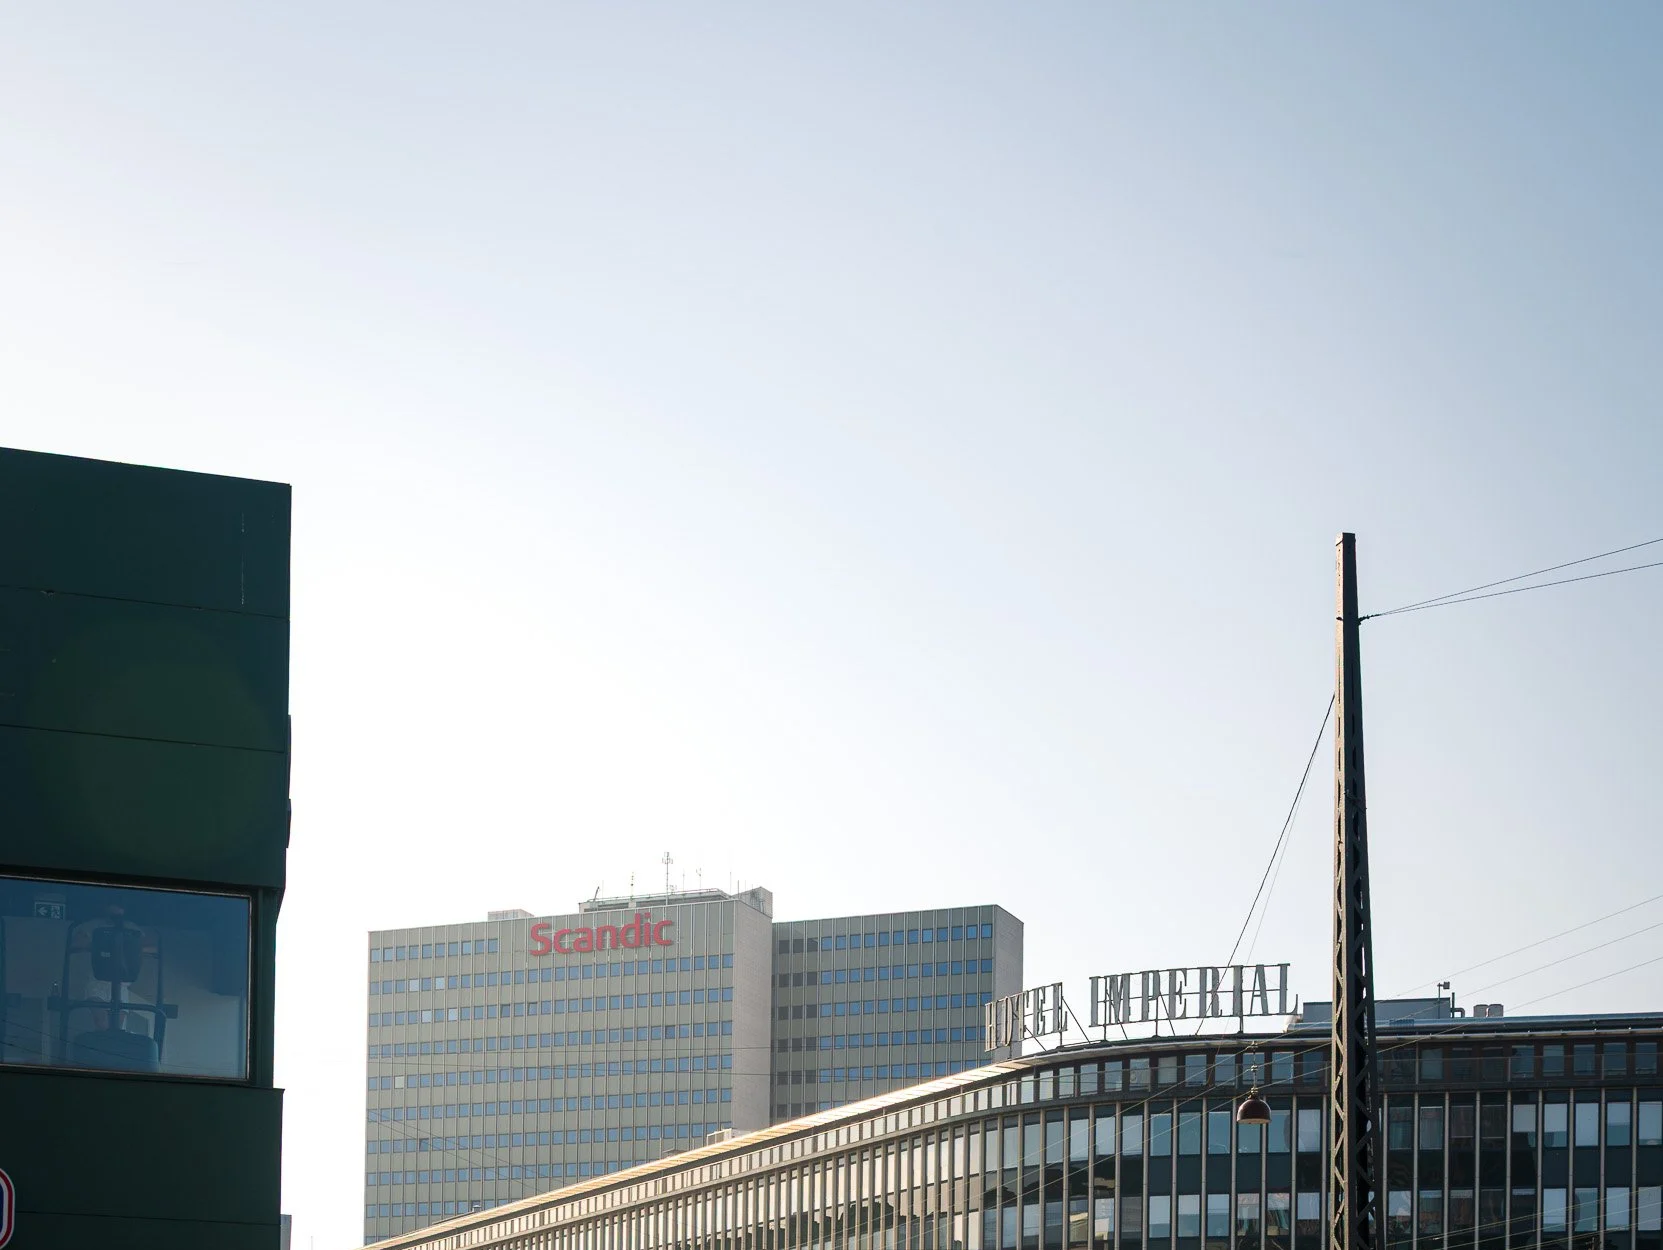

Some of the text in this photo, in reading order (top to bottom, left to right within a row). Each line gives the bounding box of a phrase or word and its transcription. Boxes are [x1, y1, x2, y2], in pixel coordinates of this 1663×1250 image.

[531, 913, 674, 957] Scandic
[985, 962, 1299, 1053] HOTEL IMPERIAL
